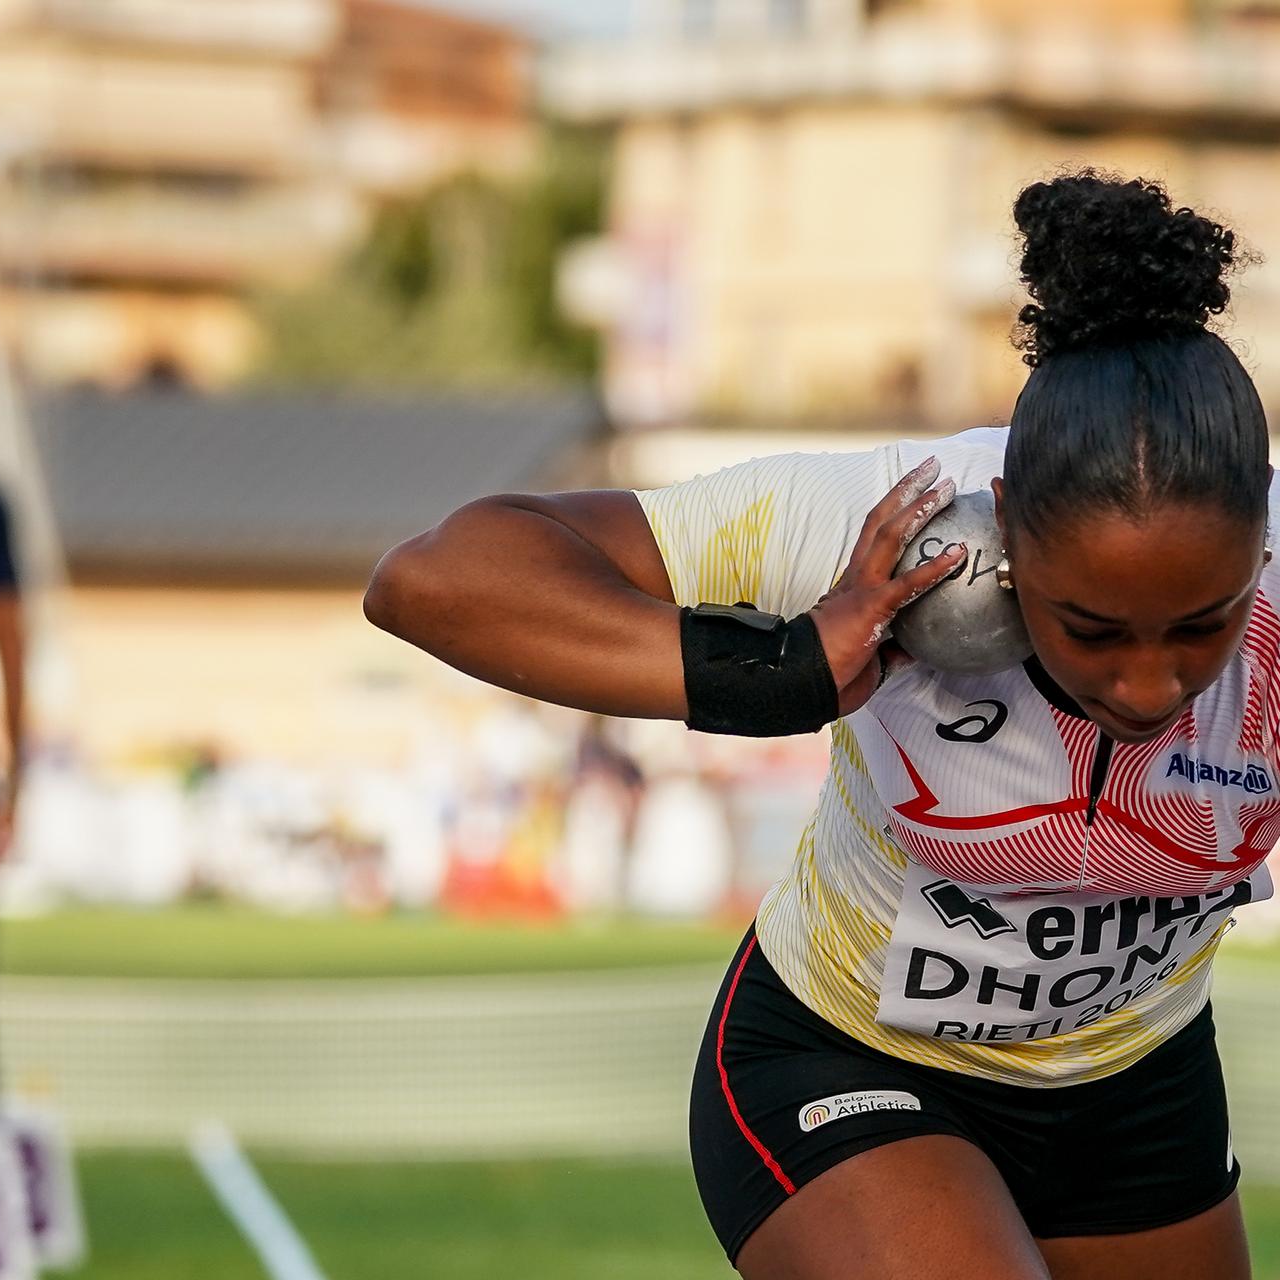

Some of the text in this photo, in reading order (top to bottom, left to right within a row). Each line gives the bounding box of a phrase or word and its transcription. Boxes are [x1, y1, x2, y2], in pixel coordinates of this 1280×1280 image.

[1166, 753, 1243, 787] Allianz
[933, 952, 1182, 1041] RIETI 2026
[834, 1093, 884, 1106] Belgian
[836, 1100, 917, 1117] Athletics
